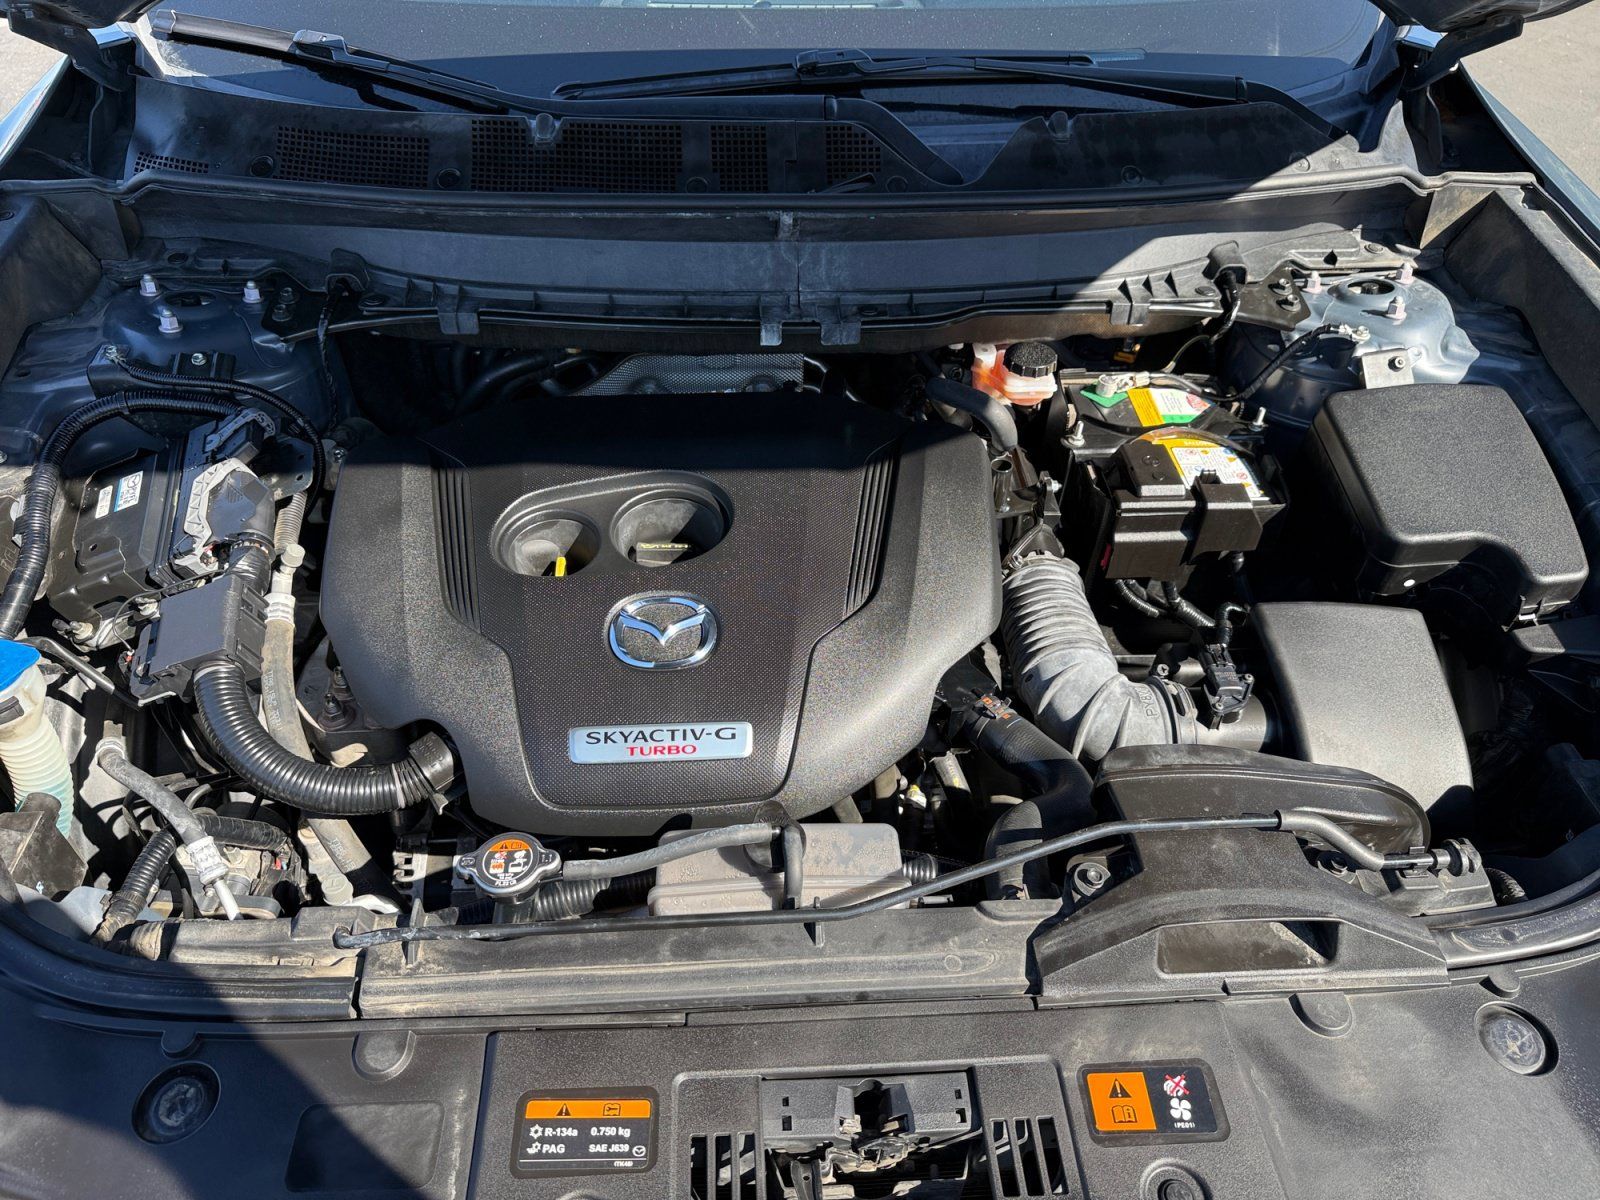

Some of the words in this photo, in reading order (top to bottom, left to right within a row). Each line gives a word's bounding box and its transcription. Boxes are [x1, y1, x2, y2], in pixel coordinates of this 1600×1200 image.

[585, 727, 737, 745] SKYACTIV-G
[626, 744, 697, 757] TURBO
[544, 1127, 578, 1137] R-134a
[590, 1126, 616, 1136] 0.750
[618, 1126, 631, 1138] kg
[542, 1144, 565, 1154] PAG
[588, 1144, 608, 1153] SAE
[609, 1144, 629, 1153] J639
